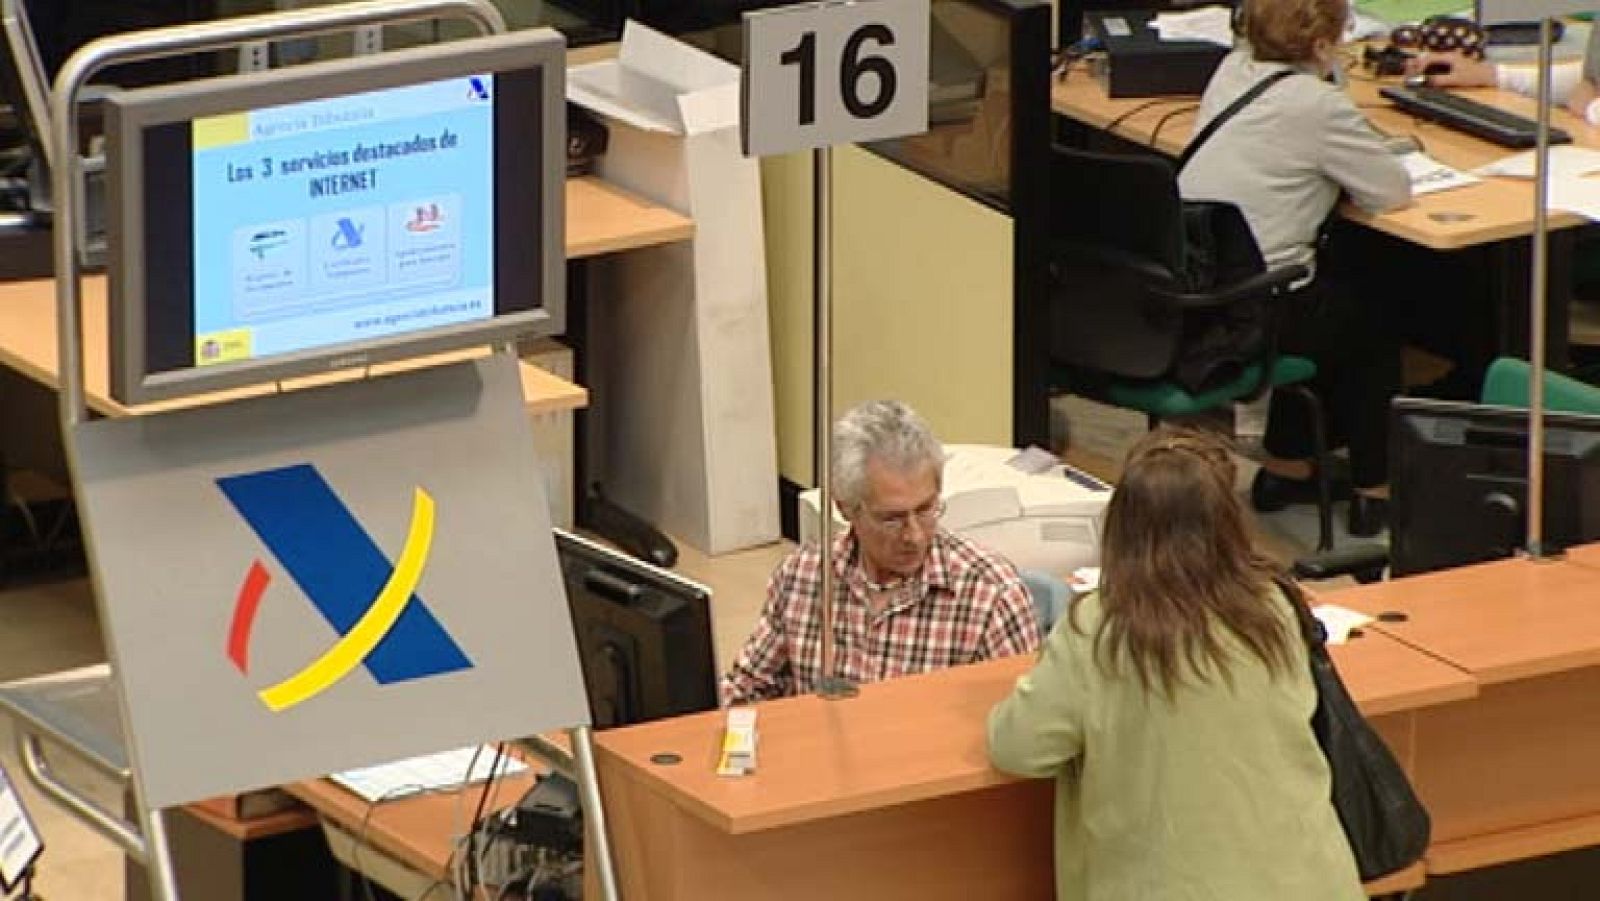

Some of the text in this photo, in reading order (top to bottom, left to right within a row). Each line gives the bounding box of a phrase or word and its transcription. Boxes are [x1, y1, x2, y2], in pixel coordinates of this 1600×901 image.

[780, 24, 897, 126] 16
[227, 127, 459, 182] Los 3 servicios destacados de
[309, 168, 378, 199] INTERNET
